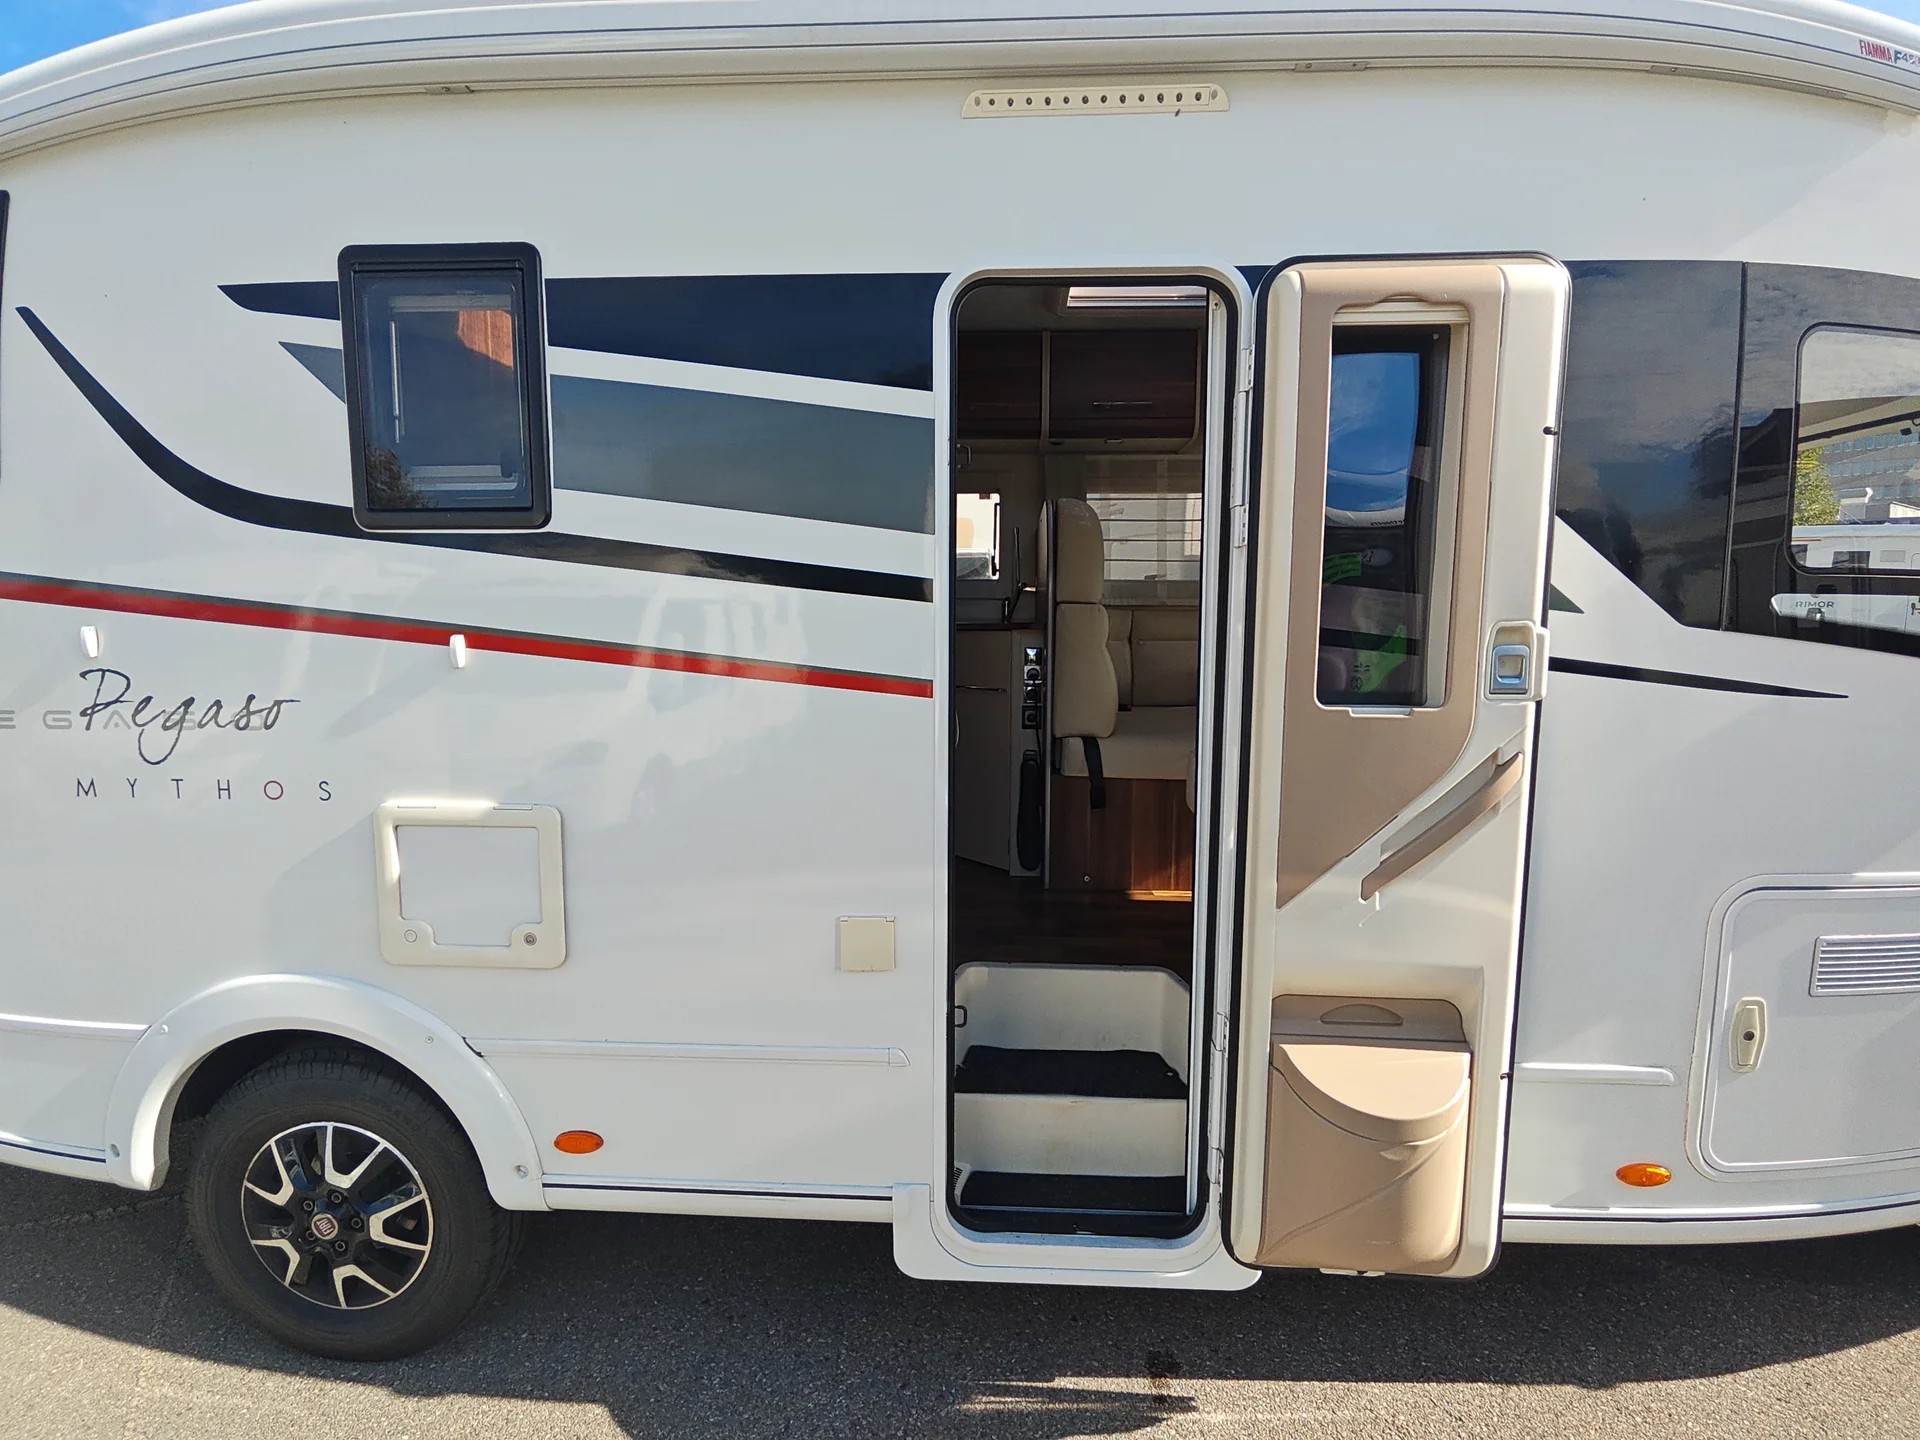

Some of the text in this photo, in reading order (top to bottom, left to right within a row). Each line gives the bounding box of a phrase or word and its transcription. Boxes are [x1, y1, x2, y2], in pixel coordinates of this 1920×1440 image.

[1859, 39, 1893, 63] FIAMMA
[1795, 600, 1834, 608] RIMOR
[79, 668, 301, 765] Pegaso
[76, 777, 332, 801] MYTHOS
[316, 1218, 334, 1235] FIAT
